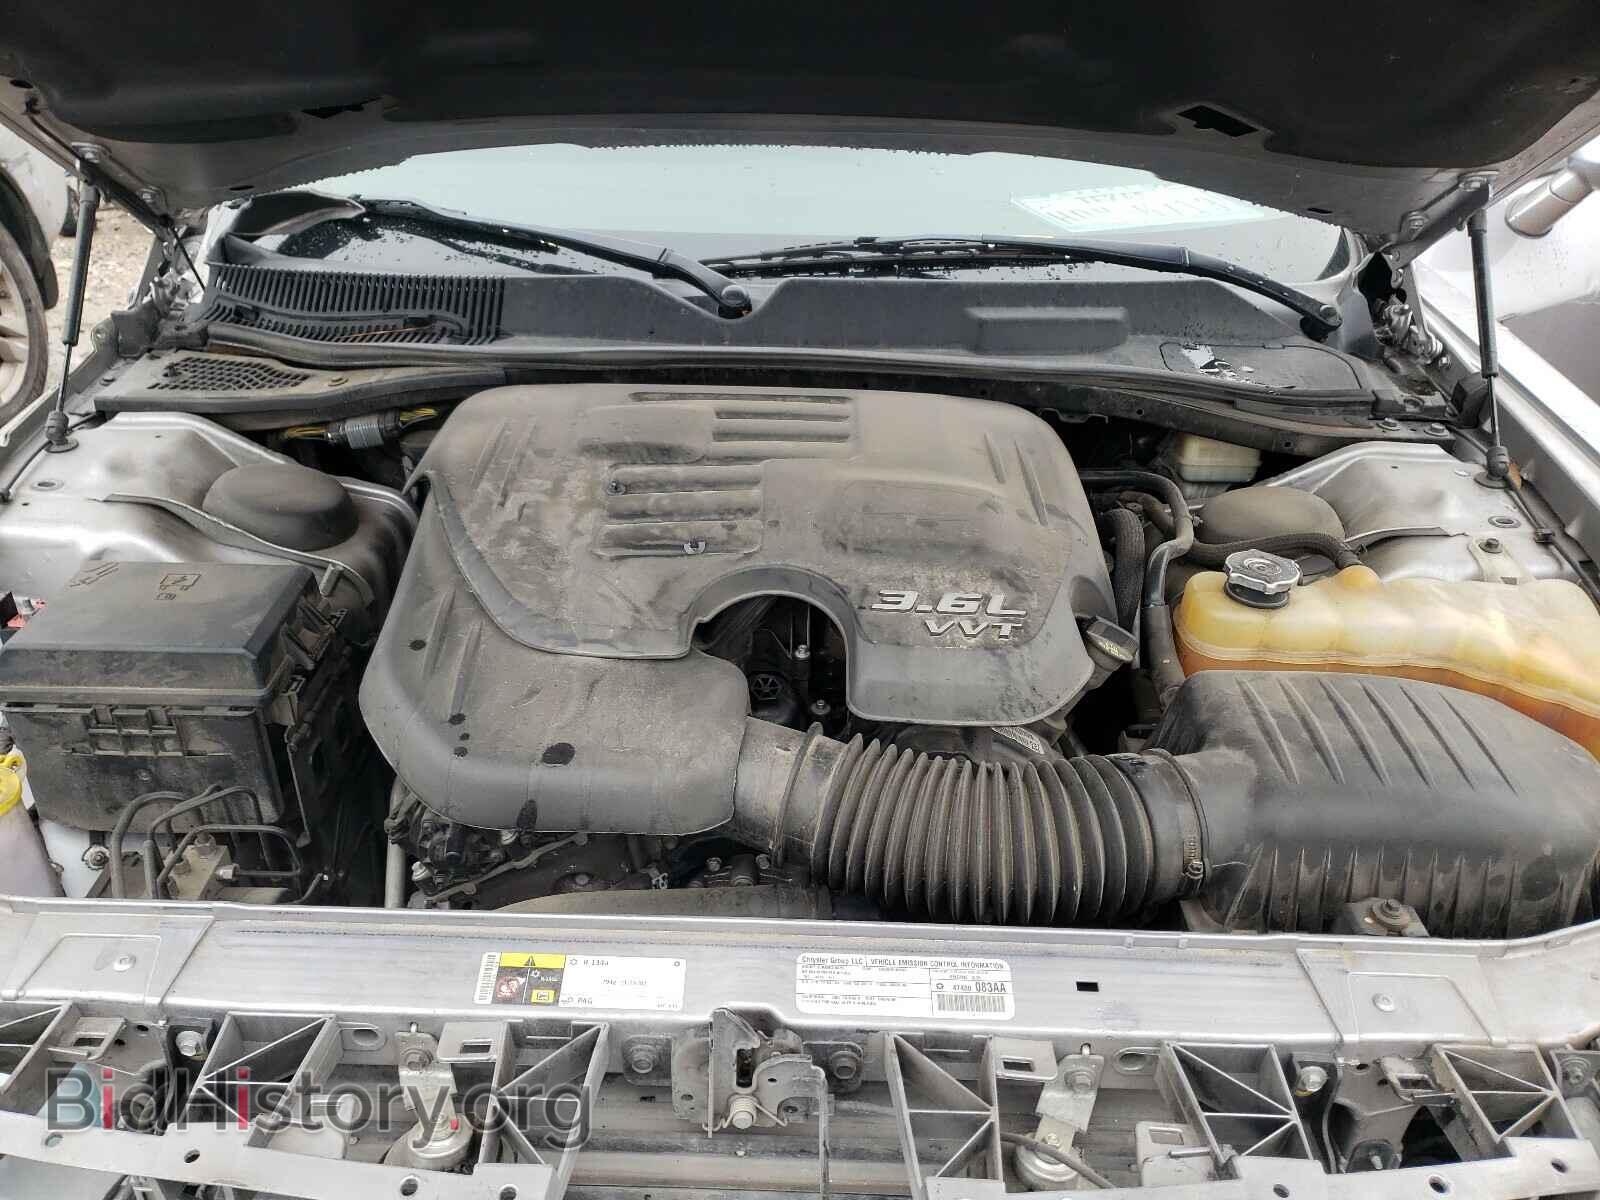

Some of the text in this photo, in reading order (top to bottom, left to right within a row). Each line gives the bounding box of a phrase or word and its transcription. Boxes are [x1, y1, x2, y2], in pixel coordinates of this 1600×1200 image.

[870, 589, 1028, 618] 3.6L
[923, 619, 1024, 640] VVT
[898, 959, 928, 967] EMISSION
[930, 960, 957, 968] CONTROL
[960, 960, 1004, 969] INFORMATION
